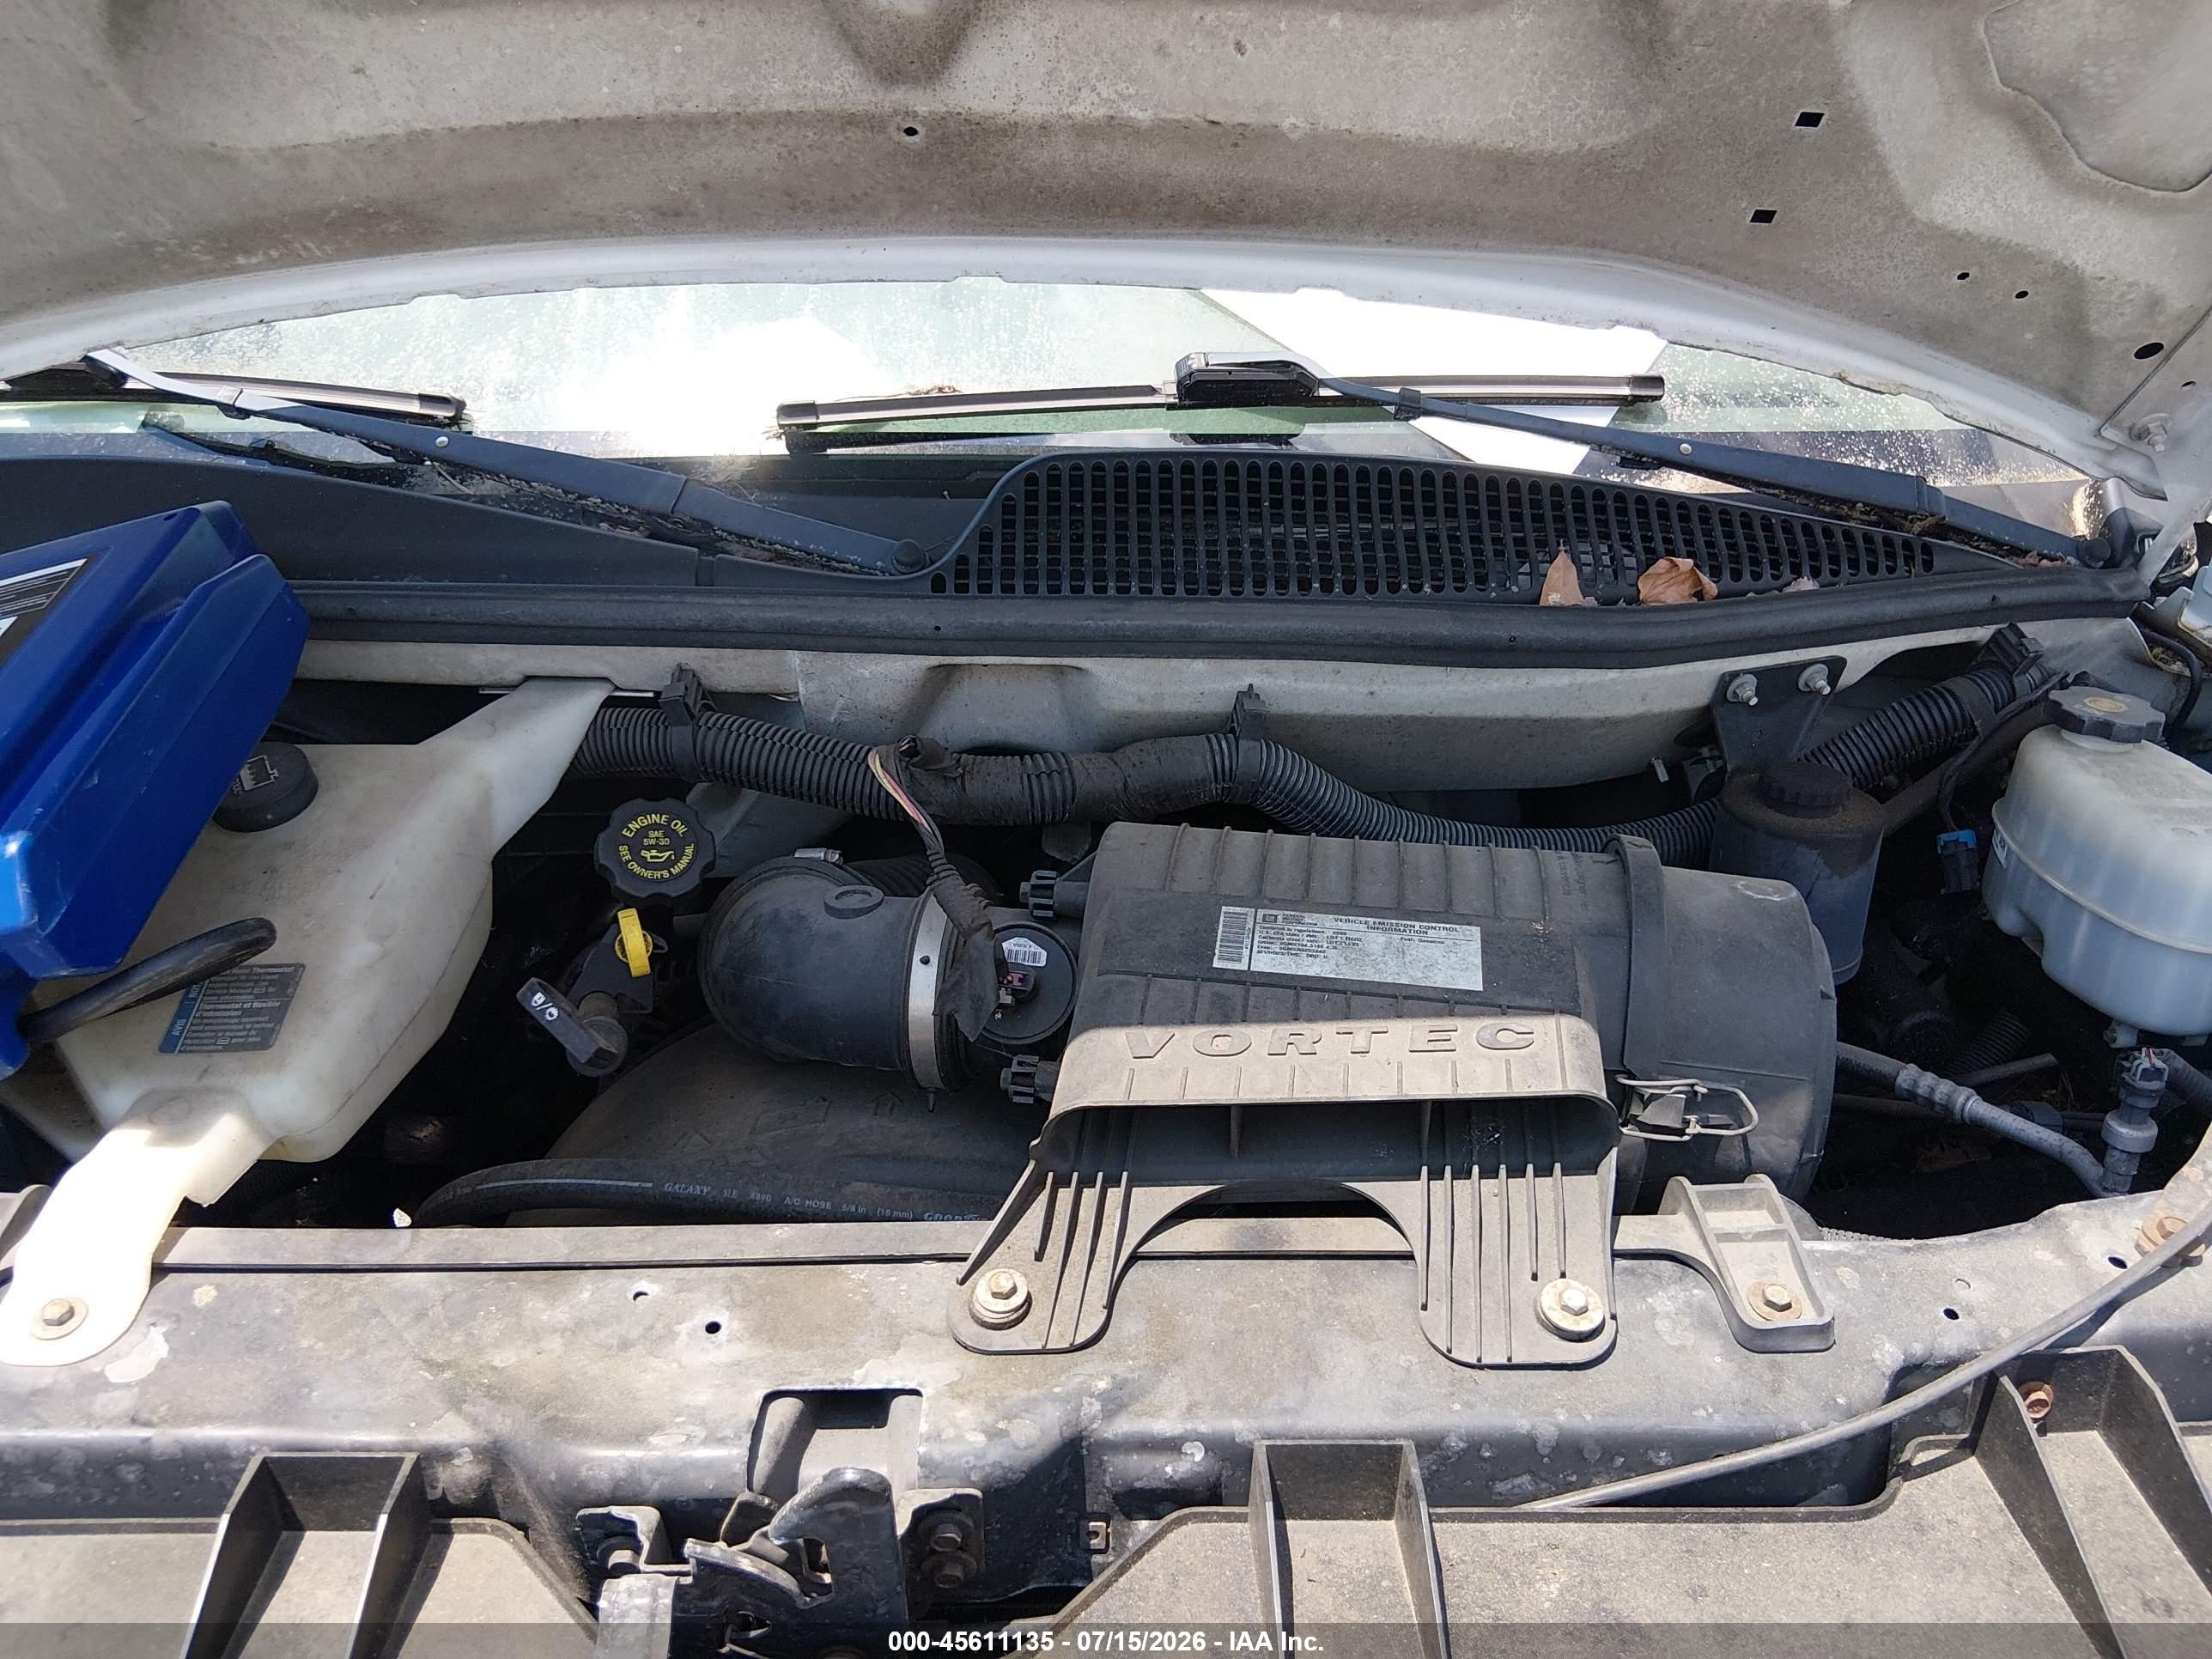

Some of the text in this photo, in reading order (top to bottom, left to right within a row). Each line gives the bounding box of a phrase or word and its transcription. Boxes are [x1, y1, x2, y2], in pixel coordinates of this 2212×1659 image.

[622, 813, 688, 838] ENGINE OIL
[618, 843, 695, 879] SEE OWNER'S MANUAL
[1333, 917, 1460, 933] VEHICLE EMISSION CONTROL
[1366, 926, 1429, 936] INFORMATION
[172, 1018, 186, 1036] AVIS
[1125, 1022, 1535, 1060] VORTEC
[664, 1182, 711, 1196] GALAXY
[723, 1188, 738, 1199] SLE
[784, 1196, 801, 1206] A/C
[805, 1200, 832, 1210] HOSE
